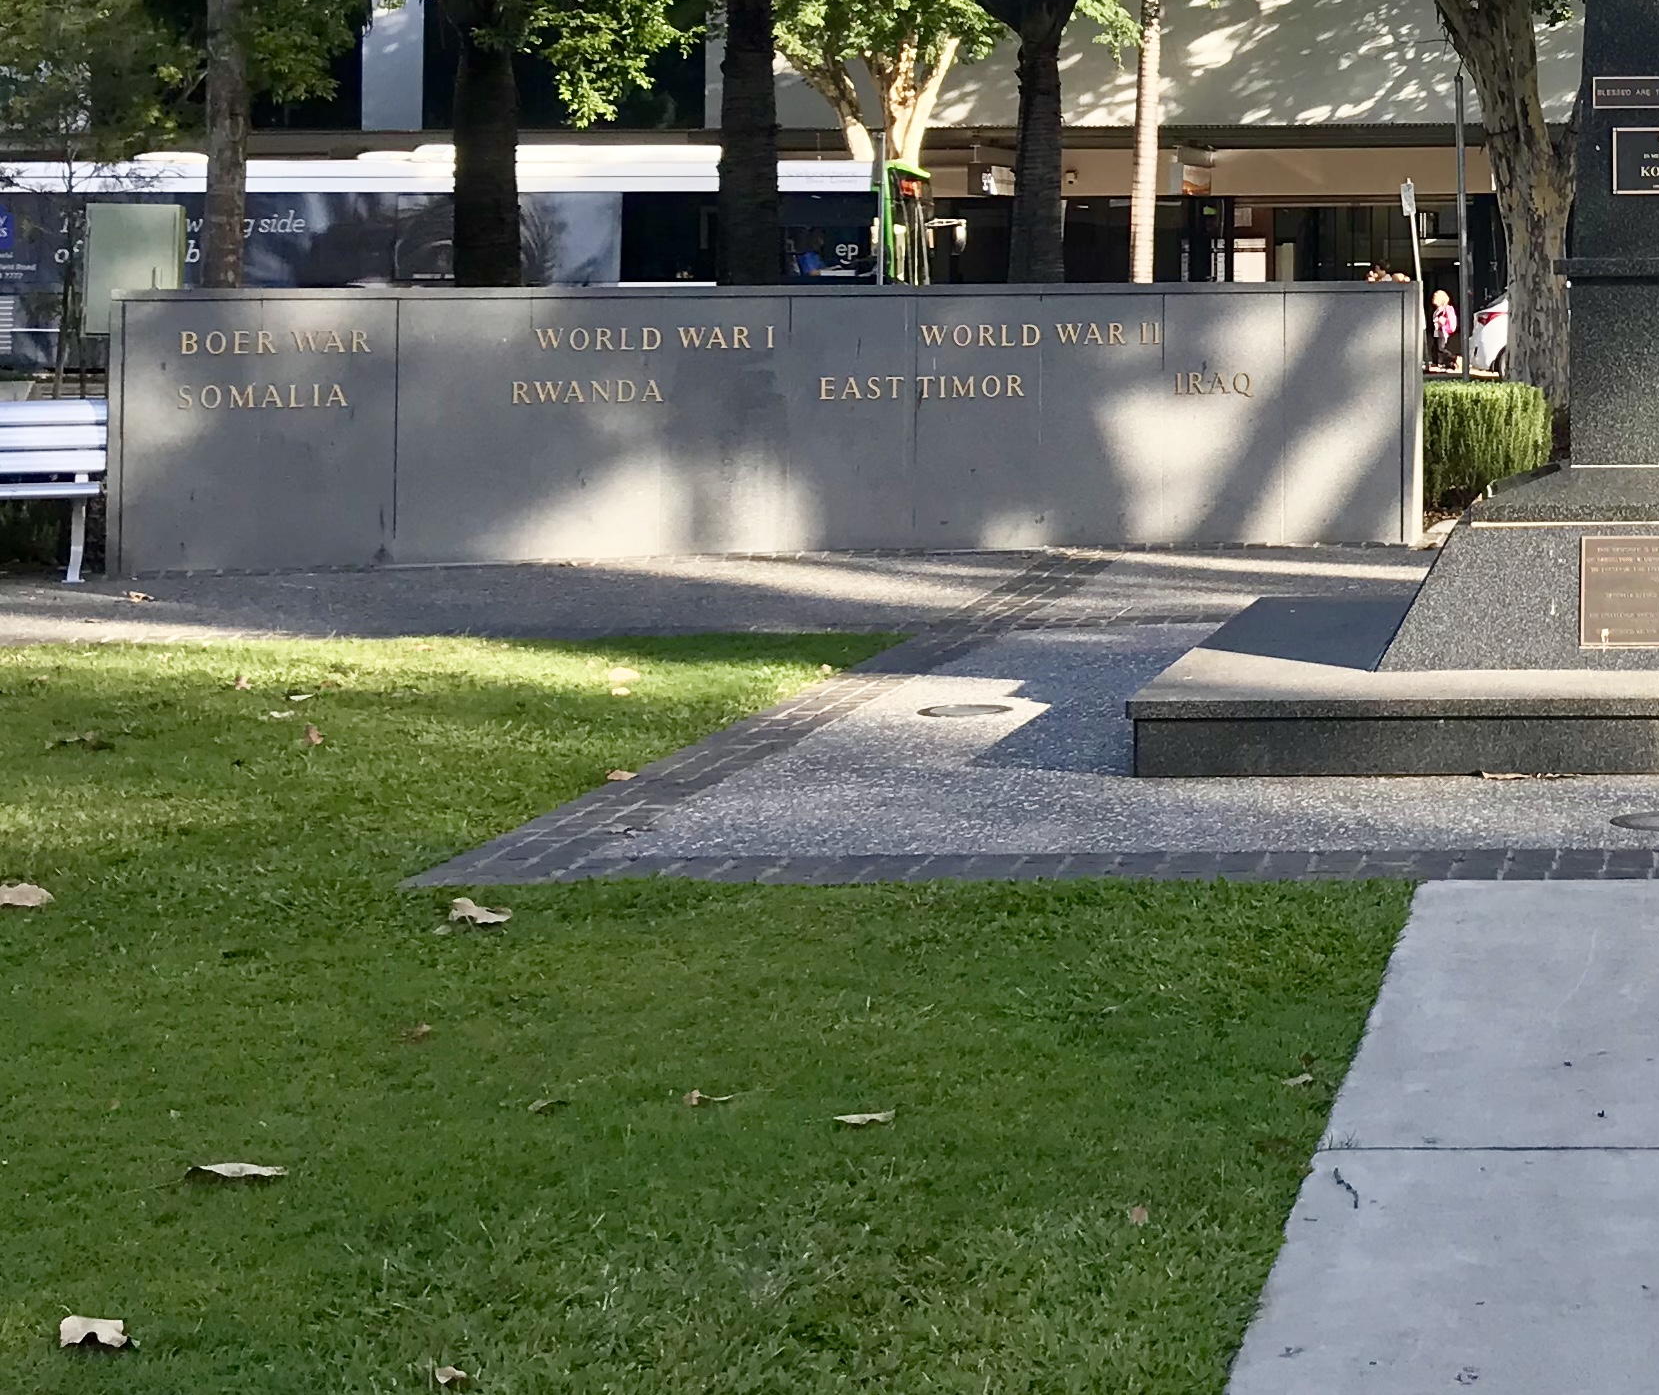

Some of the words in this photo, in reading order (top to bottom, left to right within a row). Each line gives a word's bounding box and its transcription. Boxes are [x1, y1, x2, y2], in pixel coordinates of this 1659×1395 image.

[1635, 88, 1650, 96] ARE
[258, 209, 306, 233] side
[835, 242, 859, 257] ep
[180, 330, 277, 354] BOER
[291, 329, 372, 353] WAR
[535, 327, 662, 351] WORLD
[677, 326, 752, 349] WAR
[765, 325, 775, 348] I
[920, 322, 1041, 347] WORLD
[1055, 322, 1127, 346] WAR
[1139, 321, 1162, 345] II
[178, 383, 348, 409] SOMALIA
[511, 379, 664, 404] RWANDA
[818, 375, 904, 401] EAST
[916, 374, 1025, 399] TIMOR
[1173, 371, 1254, 398] IRAQ
